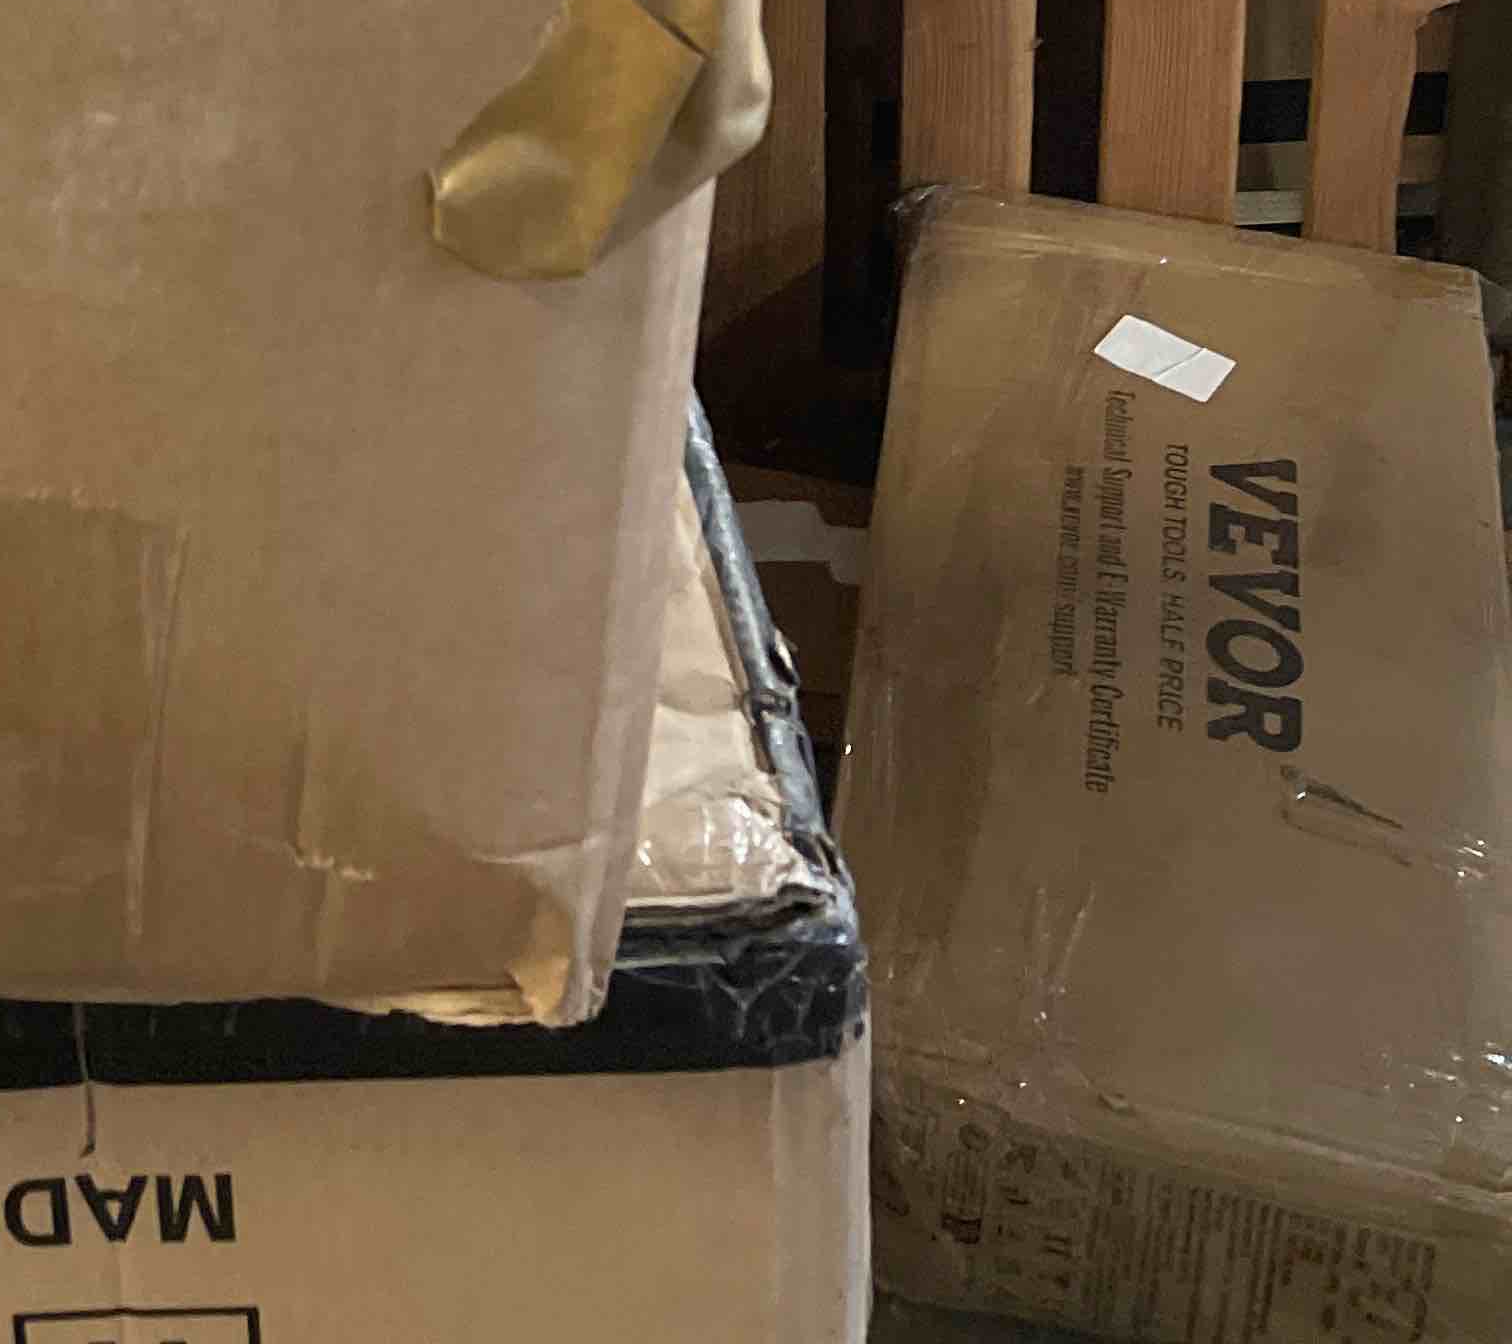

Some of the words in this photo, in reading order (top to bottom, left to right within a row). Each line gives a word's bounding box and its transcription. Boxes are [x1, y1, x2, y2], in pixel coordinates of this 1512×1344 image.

[1102, 389, 1137, 464] Technical
[1096, 467, 1133, 535] Support
[1163, 443, 1189, 511] TOUGH
[1096, 535, 1129, 566] and
[1090, 570, 1129, 679] E-Warranty
[1159, 592, 1186, 652] HALF
[1204, 458, 1303, 754] VEVOR
[1156, 657, 1184, 733] PRICE
[1084, 680, 1126, 794] Certificate
